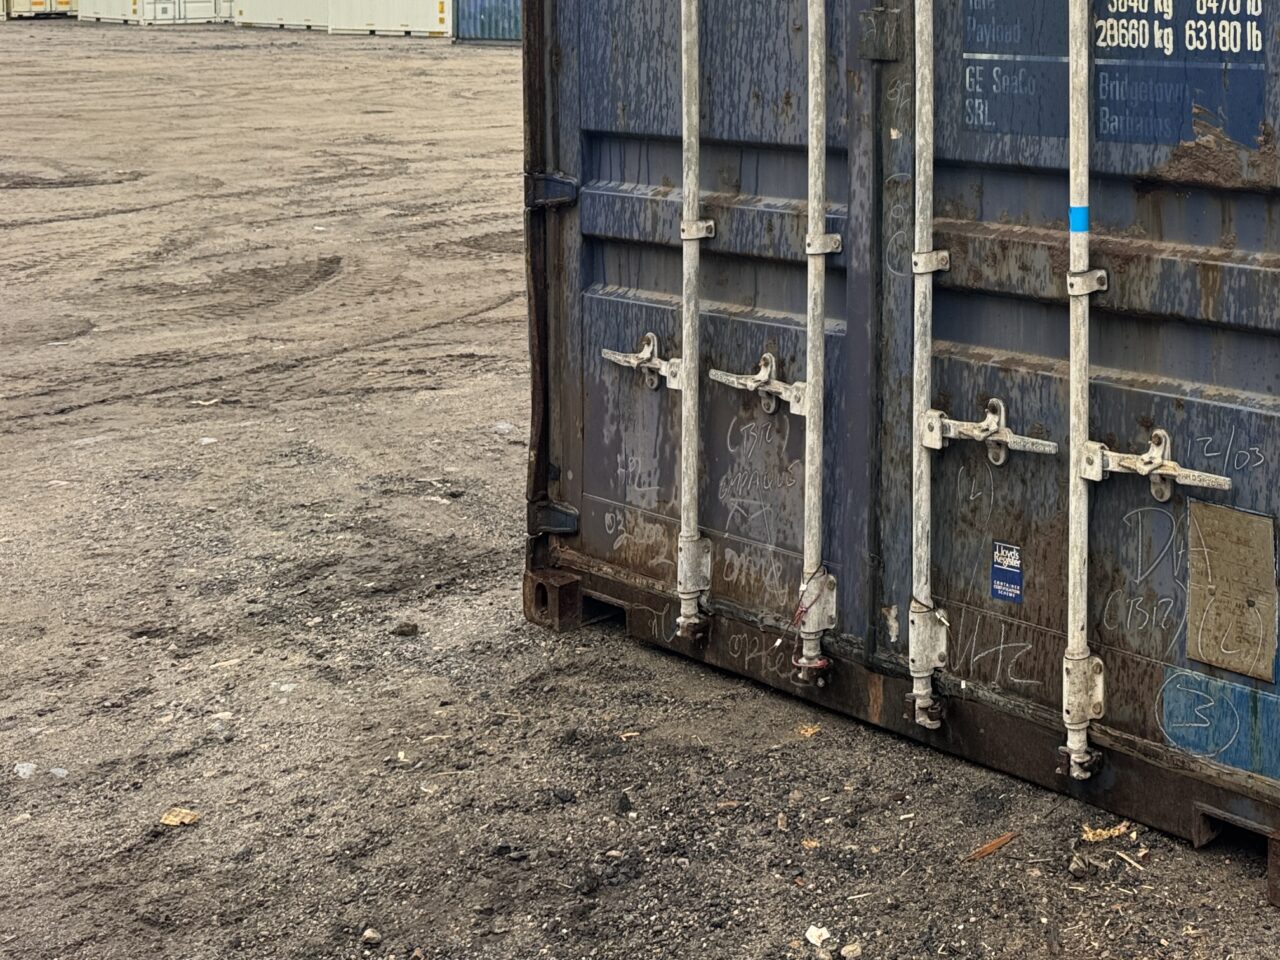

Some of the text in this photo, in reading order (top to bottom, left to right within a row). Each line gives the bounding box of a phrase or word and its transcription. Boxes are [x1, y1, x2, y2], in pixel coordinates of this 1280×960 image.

[1095, 19, 1150, 48] 28660
[1154, 19, 1173, 56] kg
[1184, 20, 1242, 52] 63180
[1246, 21, 1262, 52] lb
[965, 65, 985, 93] GE
